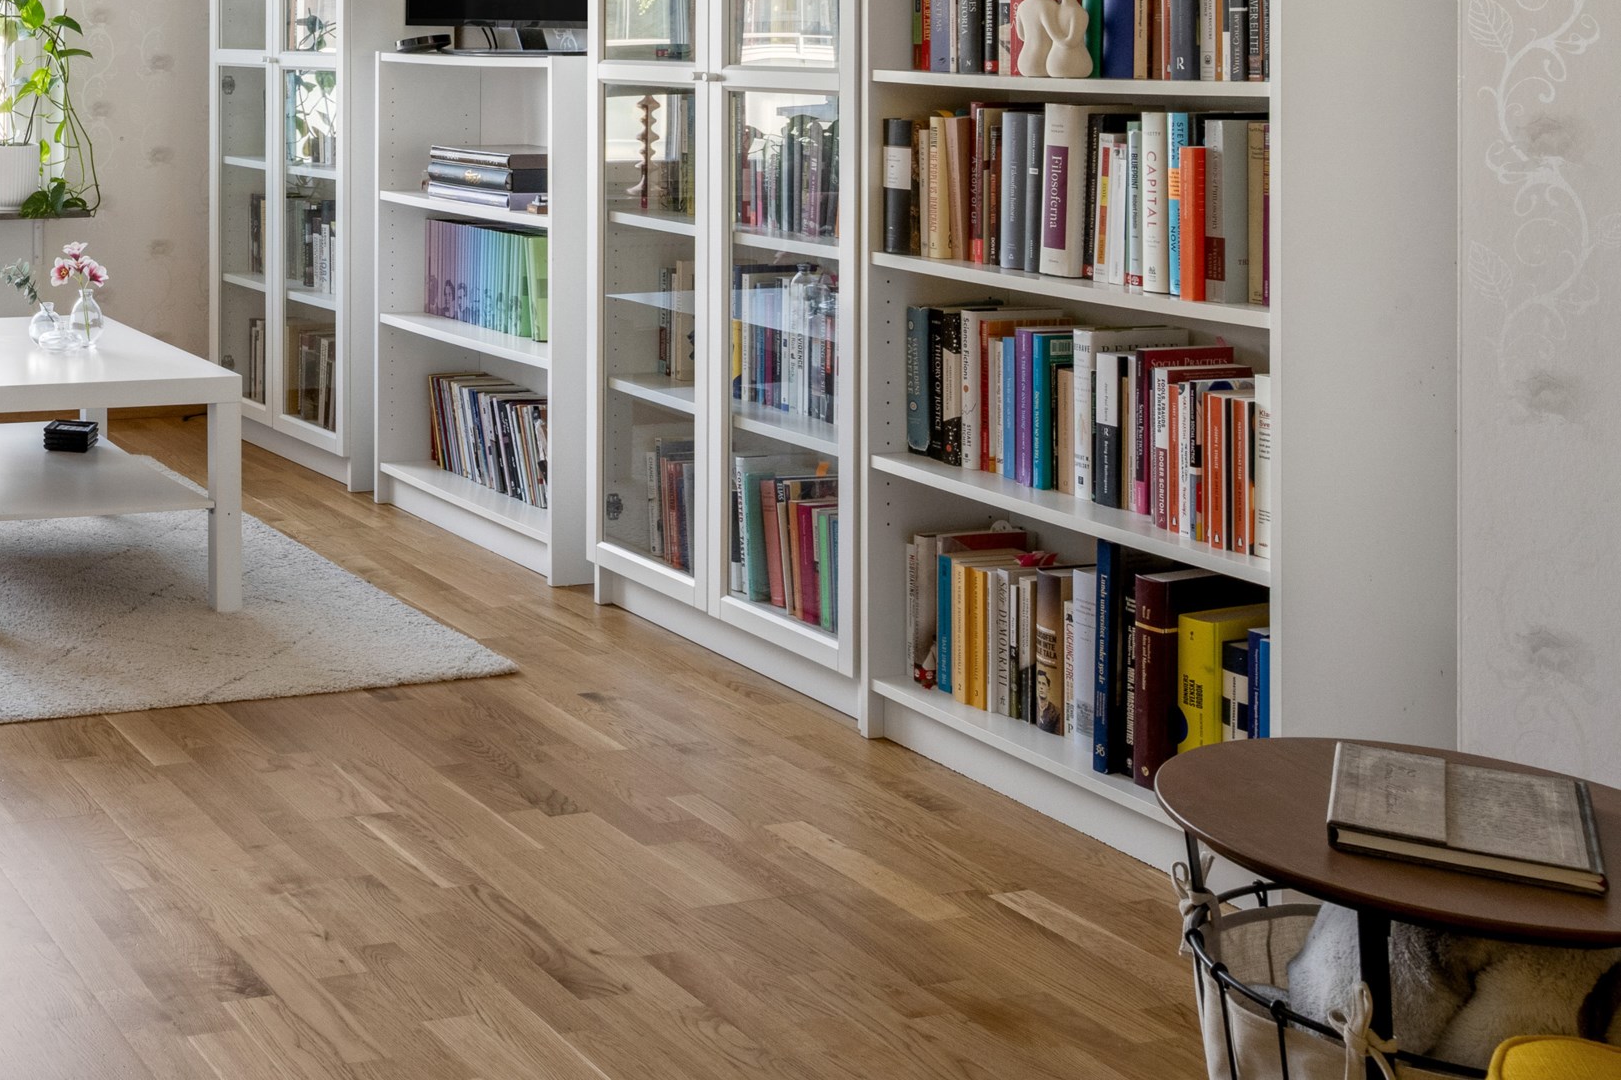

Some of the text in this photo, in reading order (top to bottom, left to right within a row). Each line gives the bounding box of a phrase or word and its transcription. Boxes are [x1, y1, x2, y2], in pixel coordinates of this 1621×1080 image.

[1248, 22, 1260, 54] ELITE
[810, 157, 818, 171] FAT
[929, 125, 938, 233] MOUNK THE PEOPLE DEMOCRACY
[969, 155, 978, 224] A Story of Us
[1048, 154, 1063, 229] Filosoferna
[1130, 152, 1139, 190] BLUEPRINT
[1146, 150, 1158, 228] CAPITAL
[1009, 164, 1017, 222] Filosofins historia
[1210, 184, 1219, 230] PHILOSOPHY
[962, 316, 970, 381] Science Fictions
[1150, 356, 1229, 367] SOCIAL PRACTICES
[934, 333, 942, 431] A THEORY OF JUSTICE
[1102, 439, 1110, 494] Being and Nothingness
[1158, 450, 1166, 514] ROGER SCRUTON
[736, 470, 745, 523] CONTESTED
[908, 553, 916, 597] MISBEHAVING
[997, 578, 1008, 687] Skör DEMOKRATI
[1042, 641, 1056, 652] INTE
[1043, 649, 1058, 661] TALA
[1065, 622, 1075, 682] CATCHING FIRE
[1097, 572, 1109, 686] Lunds universitet under 350 år
[1125, 666, 1136, 746] MEN & MASCULINITIES
[1181, 673, 1189, 706] BONNIERS
[1188, 678, 1196, 707] SVENSKA
[1195, 683, 1204, 710] ORDBOK
